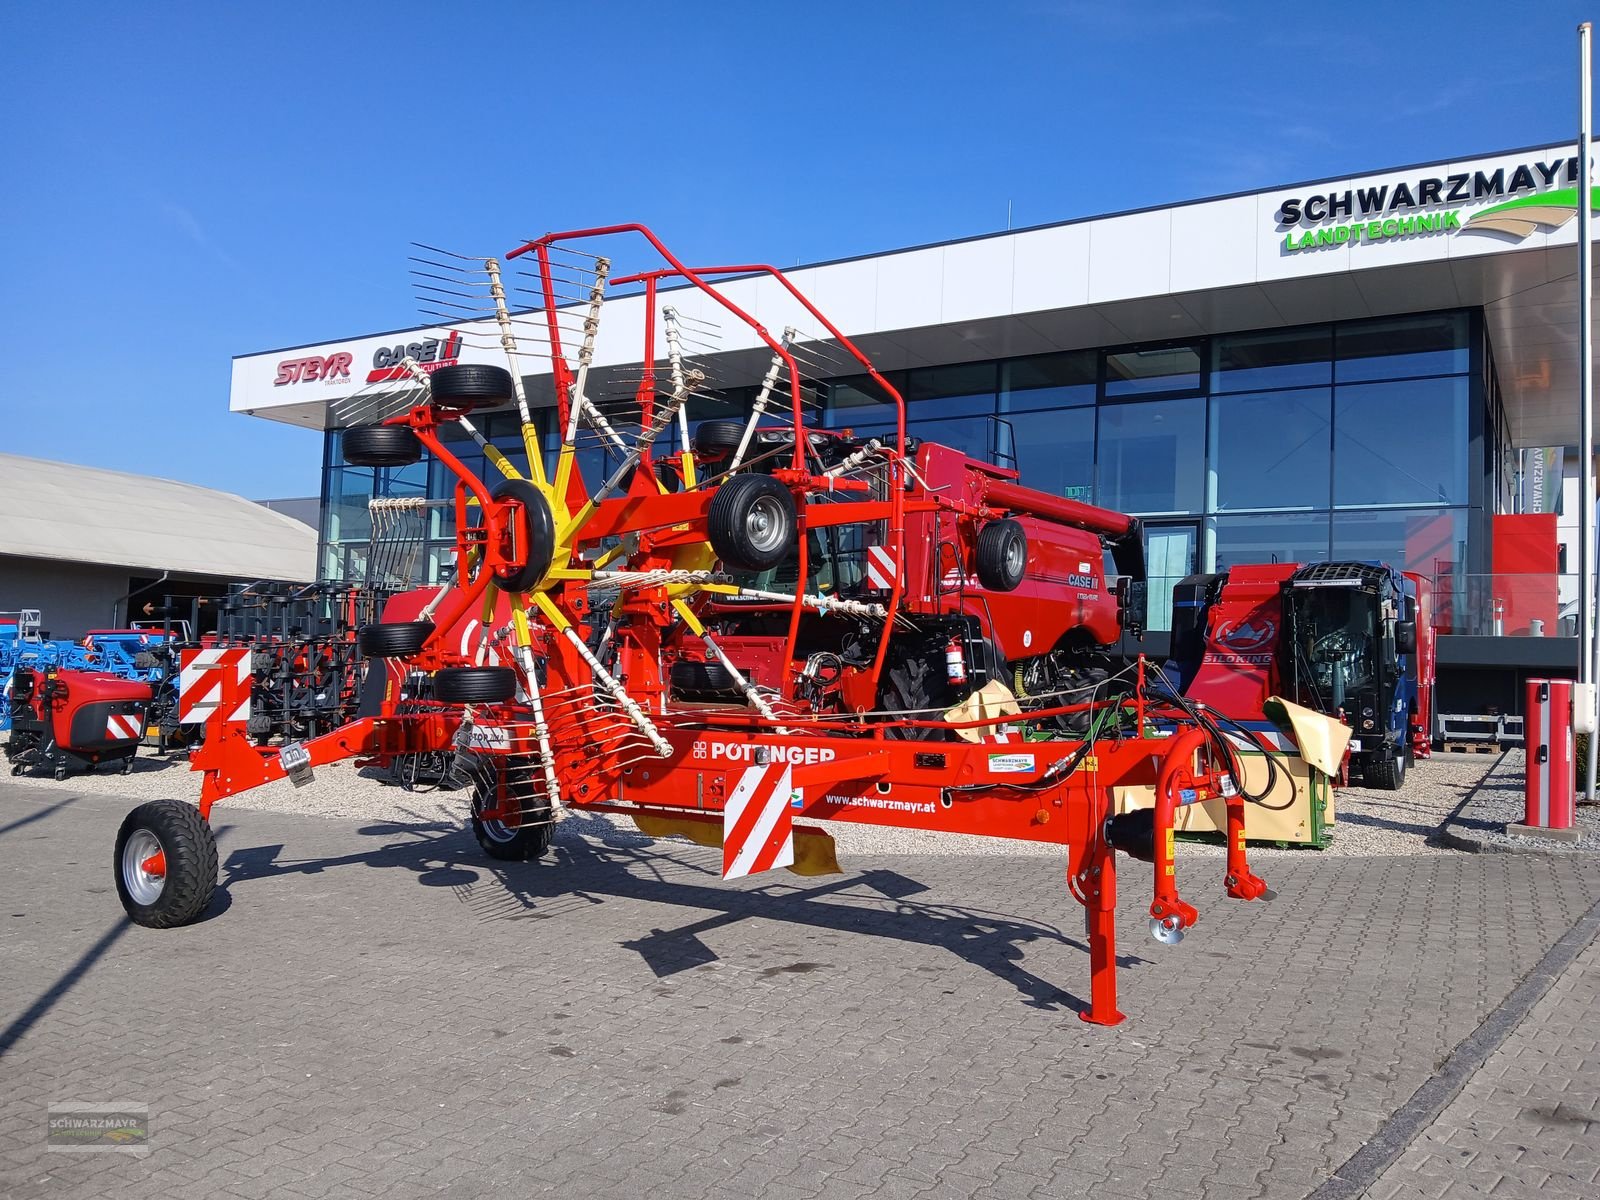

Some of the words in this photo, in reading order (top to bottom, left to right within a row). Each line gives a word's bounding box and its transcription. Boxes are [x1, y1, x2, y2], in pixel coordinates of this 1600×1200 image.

[1286, 210, 1461, 251] LANDTECHNIK
[373, 339, 440, 369] CASE
[274, 352, 354, 387] STEYR
[1533, 448, 1544, 514] CHWARZMAY
[1068, 573, 1092, 588] CASE
[1202, 655, 1273, 664] SILOKING
[826, 795, 936, 813] www.schwarzmayr.at
